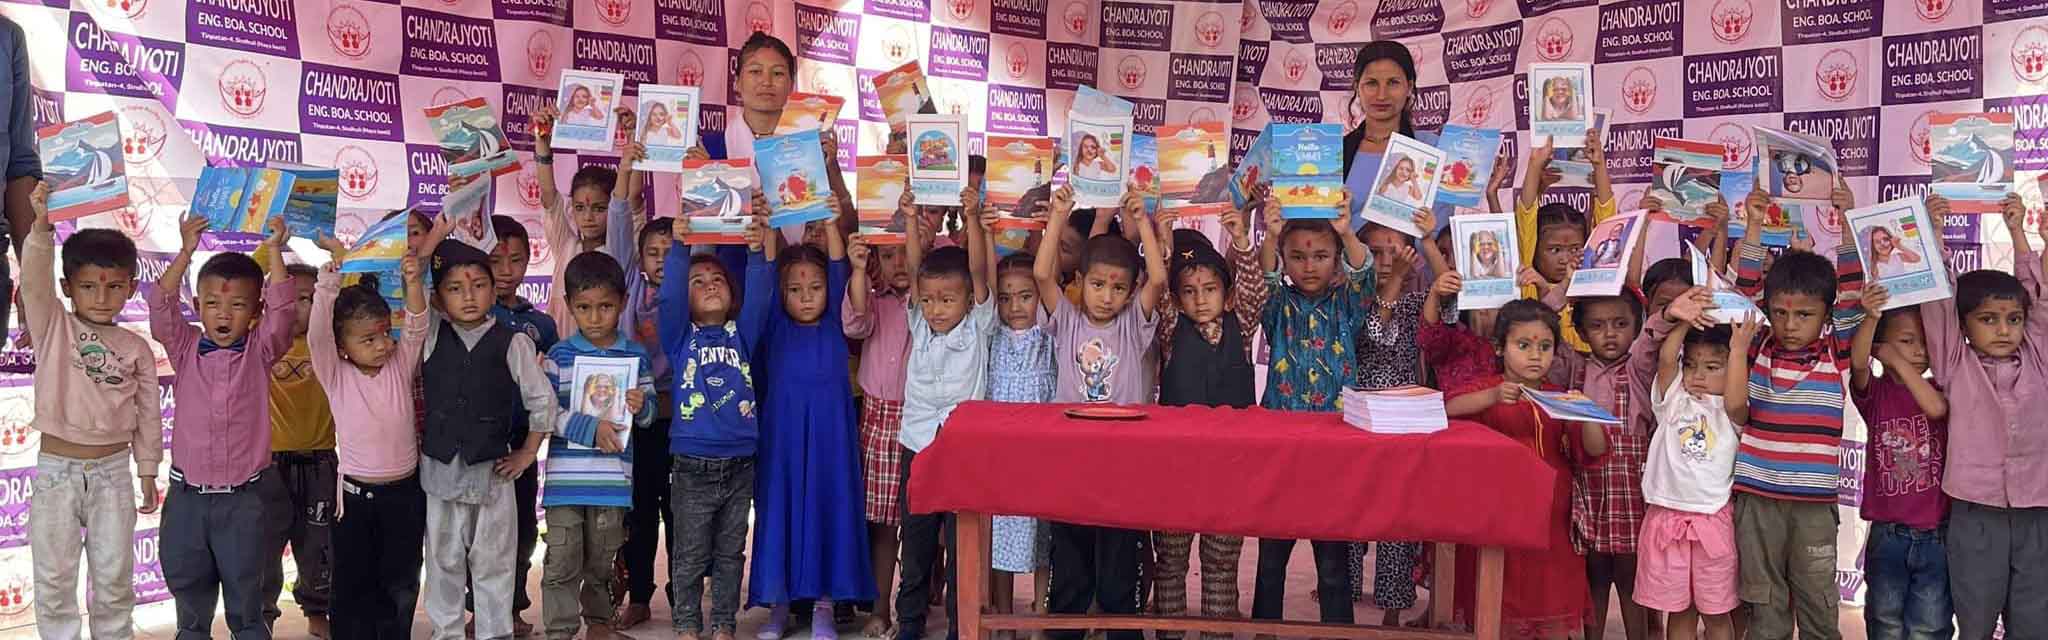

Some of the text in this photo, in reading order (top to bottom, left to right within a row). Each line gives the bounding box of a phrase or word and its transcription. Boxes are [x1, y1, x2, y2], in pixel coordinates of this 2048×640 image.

[196, 0, 291, 21] RAJYOTI
[1103, 9, 1170, 26] CHANDRAJYOTI
[1601, 2, 1680, 31] CHANDRAJYOTI
[1793, 16, 1816, 27] ENG.
[1818, 13, 1841, 25] BOA.
[198, 12, 288, 40] ENG. BOA. SCHOOL
[407, 15, 493, 48] CHANDRAJYOTI
[1105, 27, 1164, 39] ENG. BOA. SCHOOL
[932, 31, 987, 56] CHANDRAJYOTI
[1446, 27, 1520, 55] CHANDRAJYOTI
[1602, 30, 1674, 47] ENG. BOA. SCHOOL
[75, 22, 179, 77] CHAAJYOTI
[410, 47, 488, 66] ENG. BOA. SCHOOL
[576, 38, 653, 65] CHANDRAJYOTI
[1319, 47, 1358, 65] CHANDRAJ
[1887, 35, 1979, 68] CHANDRAJYOTI
[80, 58, 139, 76] ENG. BO
[1173, 58, 1232, 78] CHANDRAJYOTI
[1451, 60, 1469, 70] ENG.
[1470, 57, 1488, 67] BOA.
[1687, 55, 1778, 84] CHANDRAJYOTI
[1175, 79, 1192, 88] ENG.
[1193, 80, 1208, 89] BOA.
[1891, 69, 1974, 86] ENG. BOA. SCHOOL
[304, 70, 397, 105] CHANDRAJYOTI
[1693, 85, 1773, 101] ENG. BOA. SCHOOL
[989, 88, 1043, 110] CHANDRAJYOTI
[1262, 92, 1321, 113] HANDRAJYOTI
[1414, 91, 1448, 110] AJYOTI
[308, 104, 393, 124] ENG. BOA. SCHOOL
[1016, 114, 1040, 123] SCHOOL
[1133, 103, 1163, 121] AJYOTI
[186, 129, 298, 164] ANDRAJYOTI
[1604, 127, 1679, 152] HANDRAJ
[1606, 158, 1622, 168] ENG.
[418, 183, 437, 194] ENG.
[1943, 215, 1970, 227] HOOL
